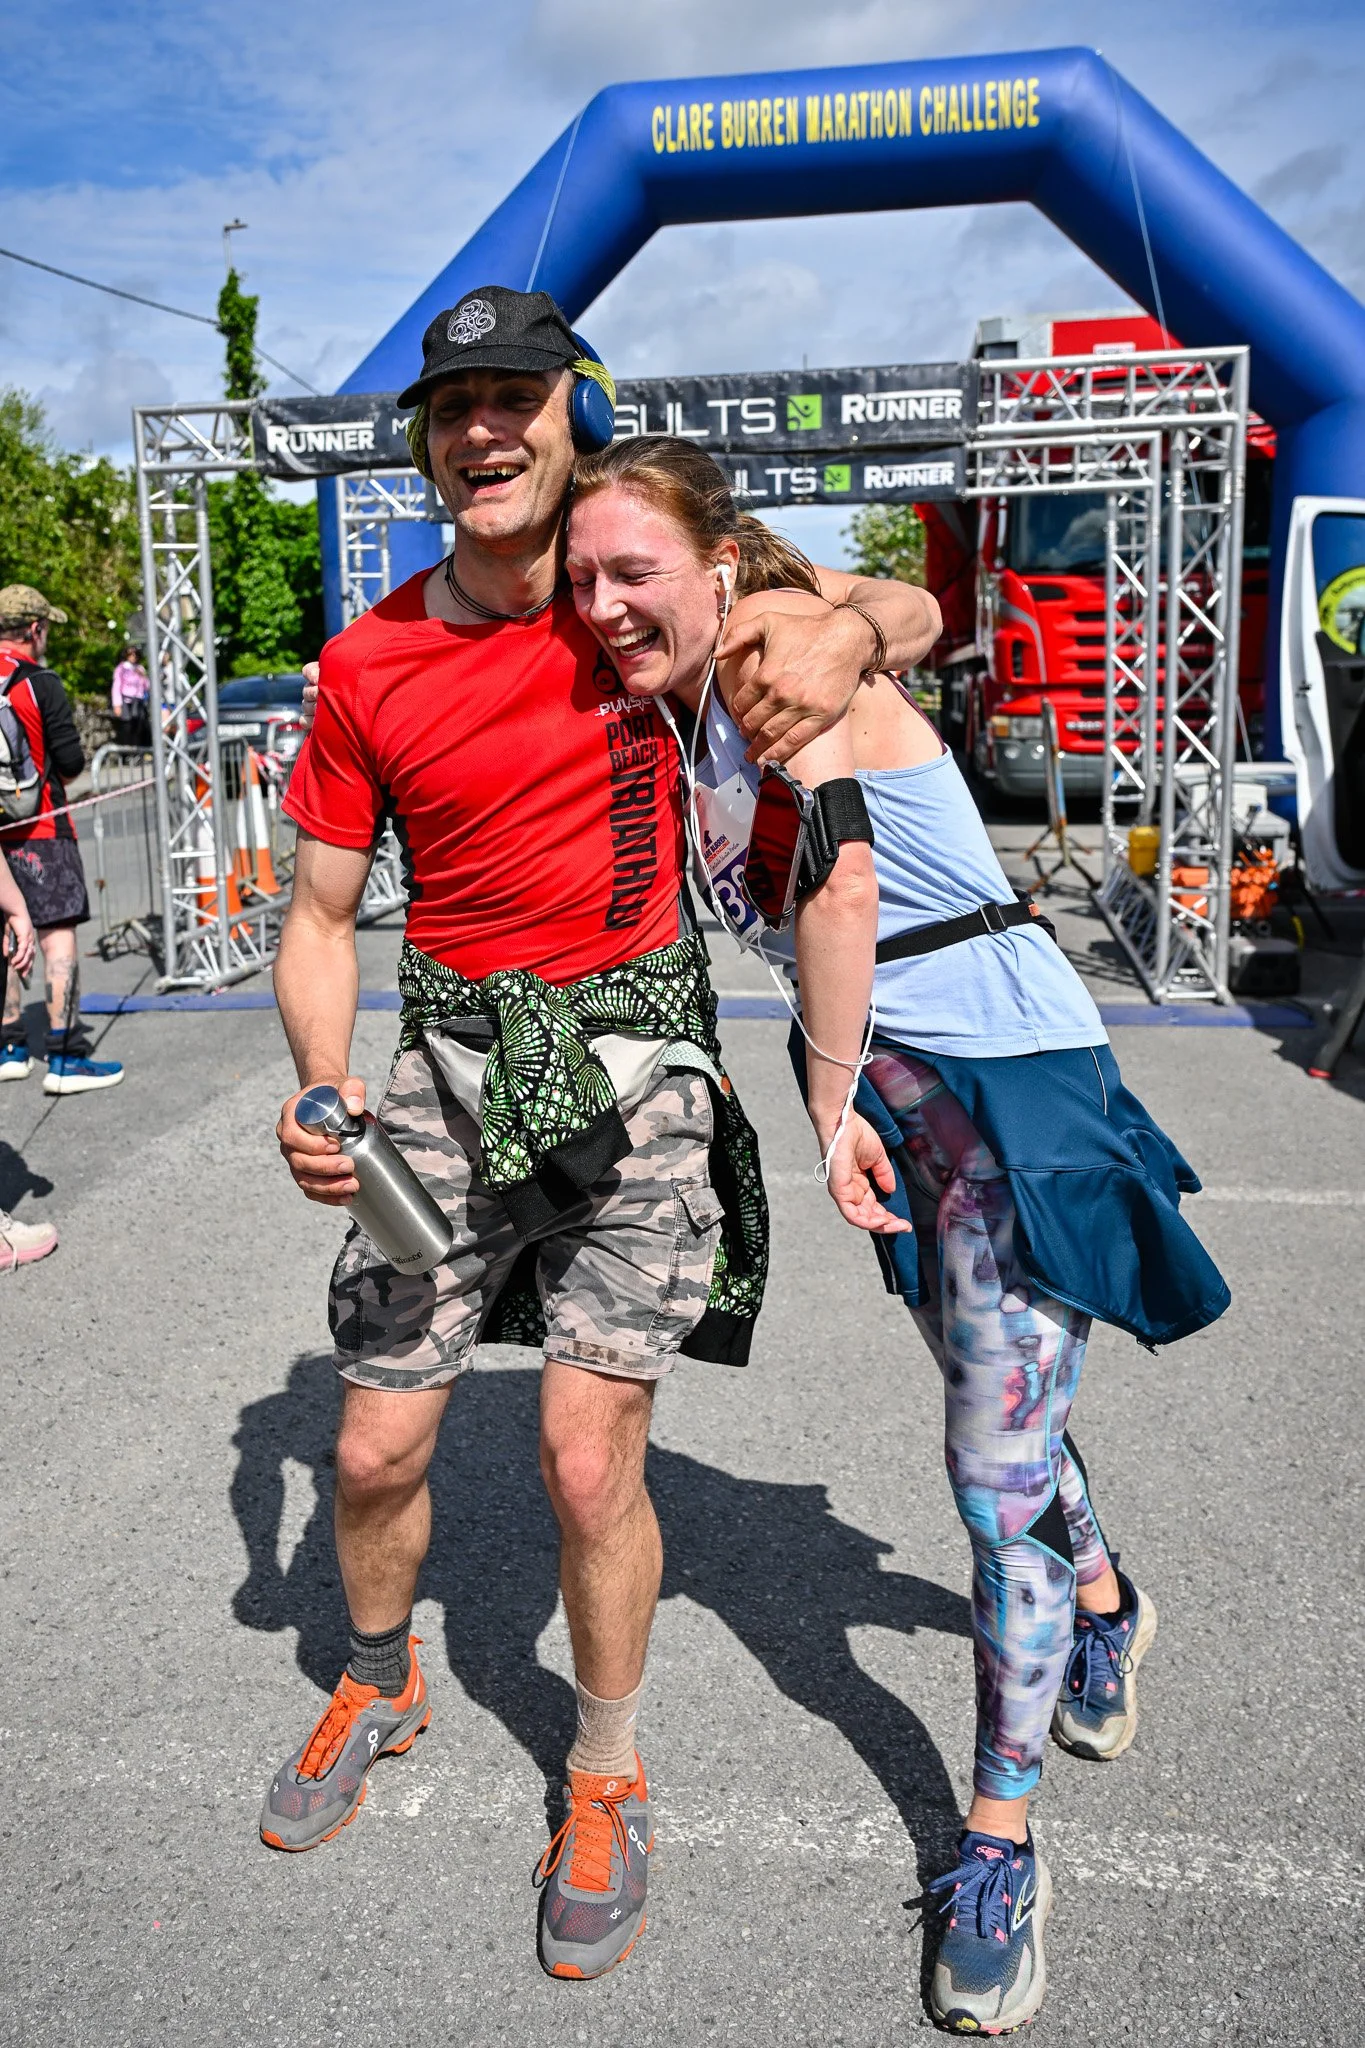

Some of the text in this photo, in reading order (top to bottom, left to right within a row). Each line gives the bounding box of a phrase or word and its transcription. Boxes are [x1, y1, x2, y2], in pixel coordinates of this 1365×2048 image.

[652, 77, 1040, 153] CLARE BURREN MARATHON CHALLENGE
[841, 389, 963, 425] RUNNER
[267, 421, 375, 453] RUNNER
[864, 462, 955, 490] RUNNER
[605, 713, 655, 750] PORT
[609, 741, 658, 772] BEACH
